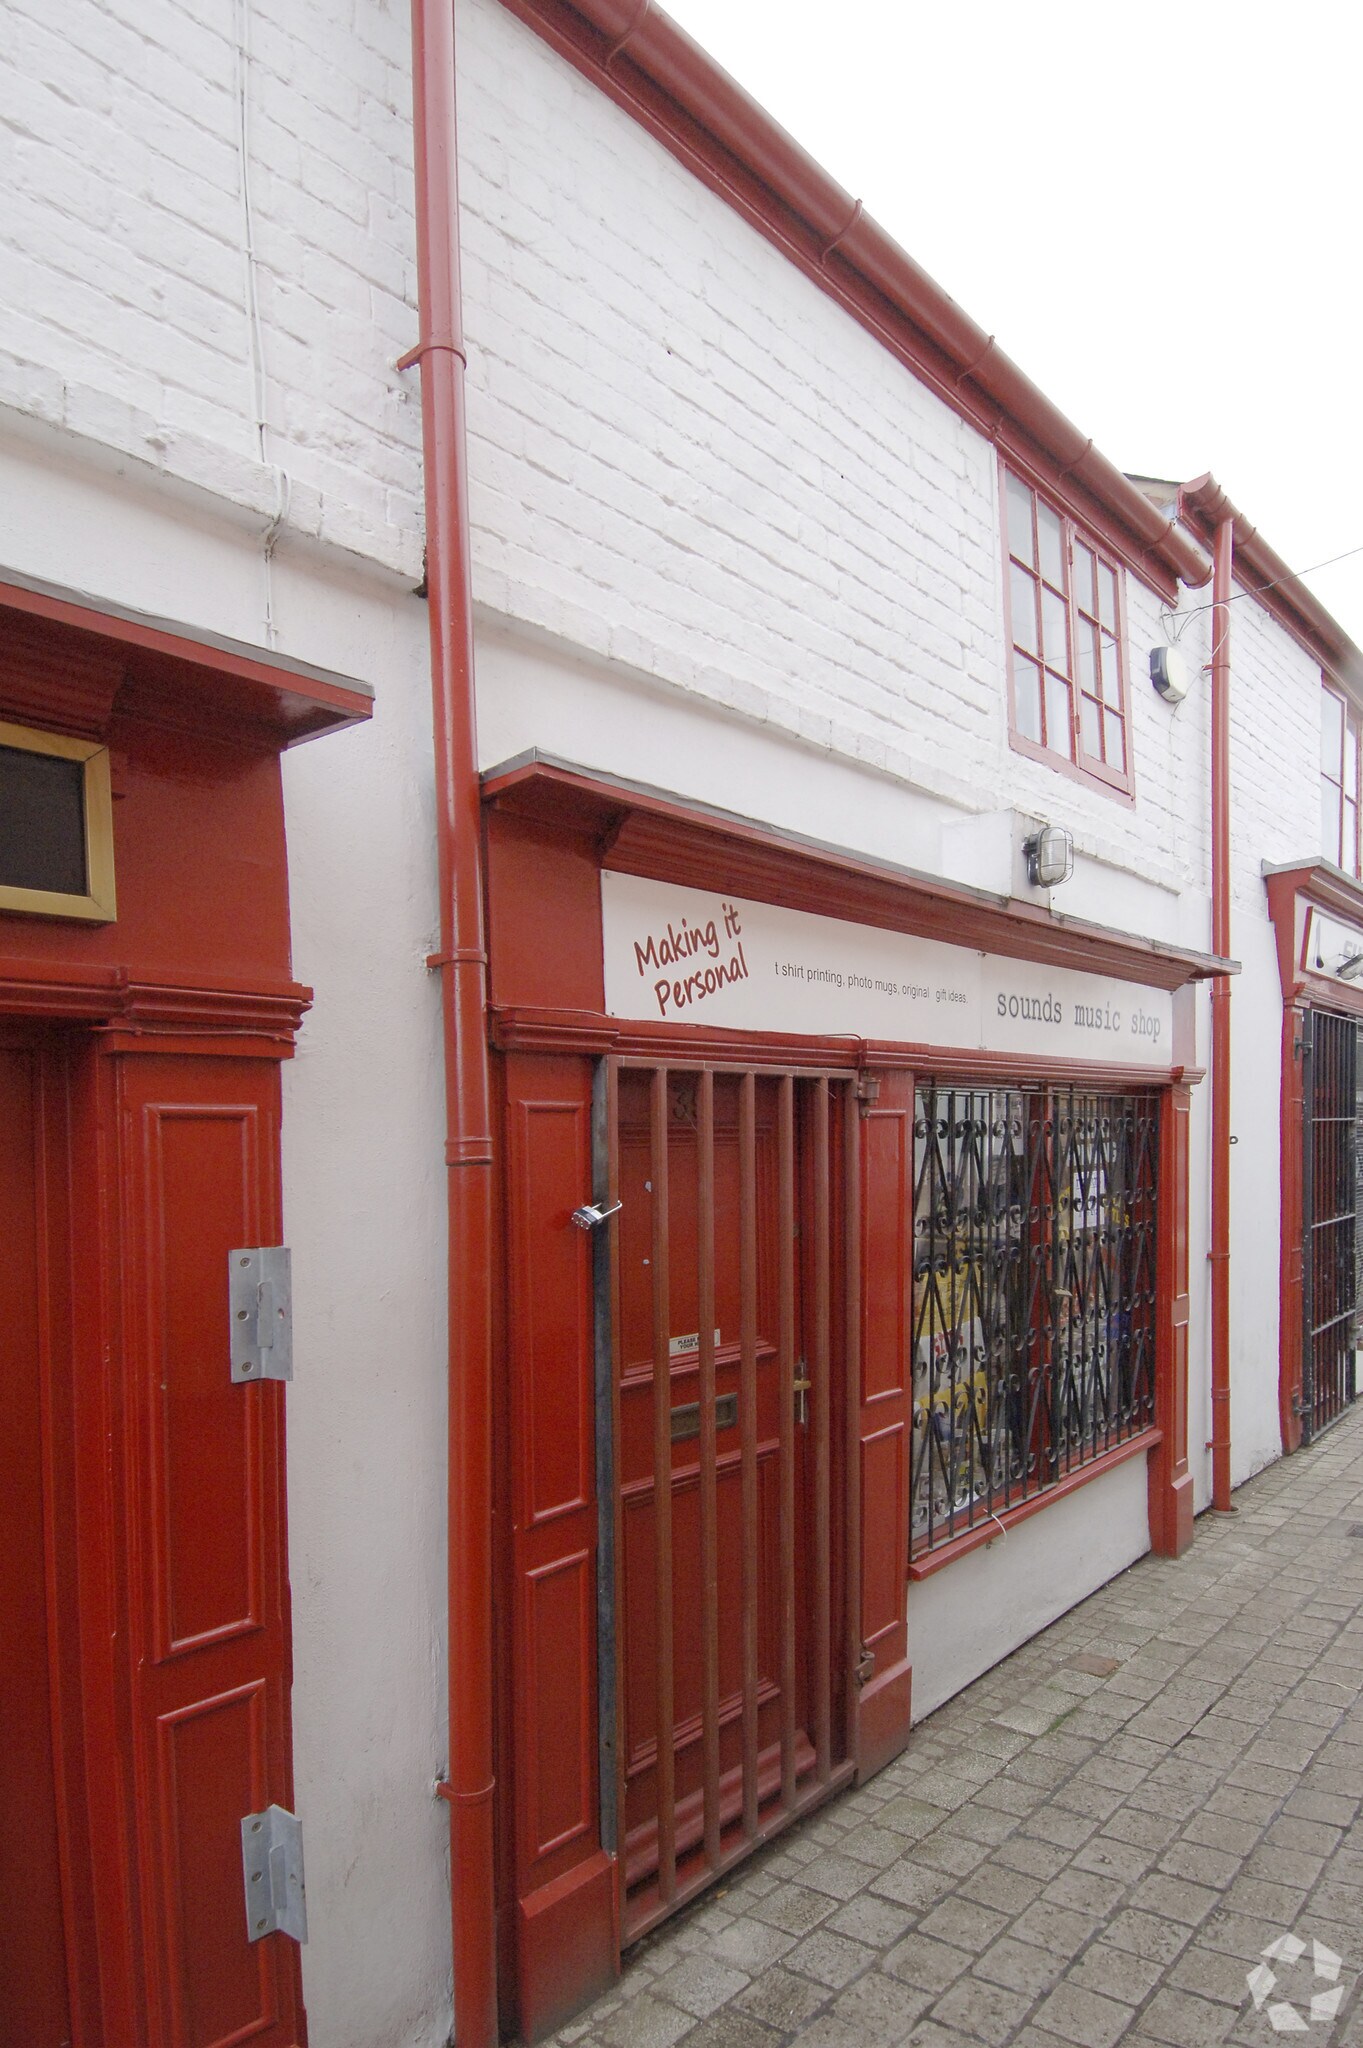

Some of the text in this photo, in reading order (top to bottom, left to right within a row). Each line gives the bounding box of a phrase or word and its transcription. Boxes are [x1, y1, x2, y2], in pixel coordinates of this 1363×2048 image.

[633, 902, 742, 976] Making it
[654, 941, 749, 1016] Personal
[774, 962, 779, 975] t
[781, 964, 804, 979] shirt
[848, 974, 873, 990] photo
[902, 984, 930, 999] original
[935, 989, 948, 1003] gift
[997, 993, 1161, 1043] sounds music shop
